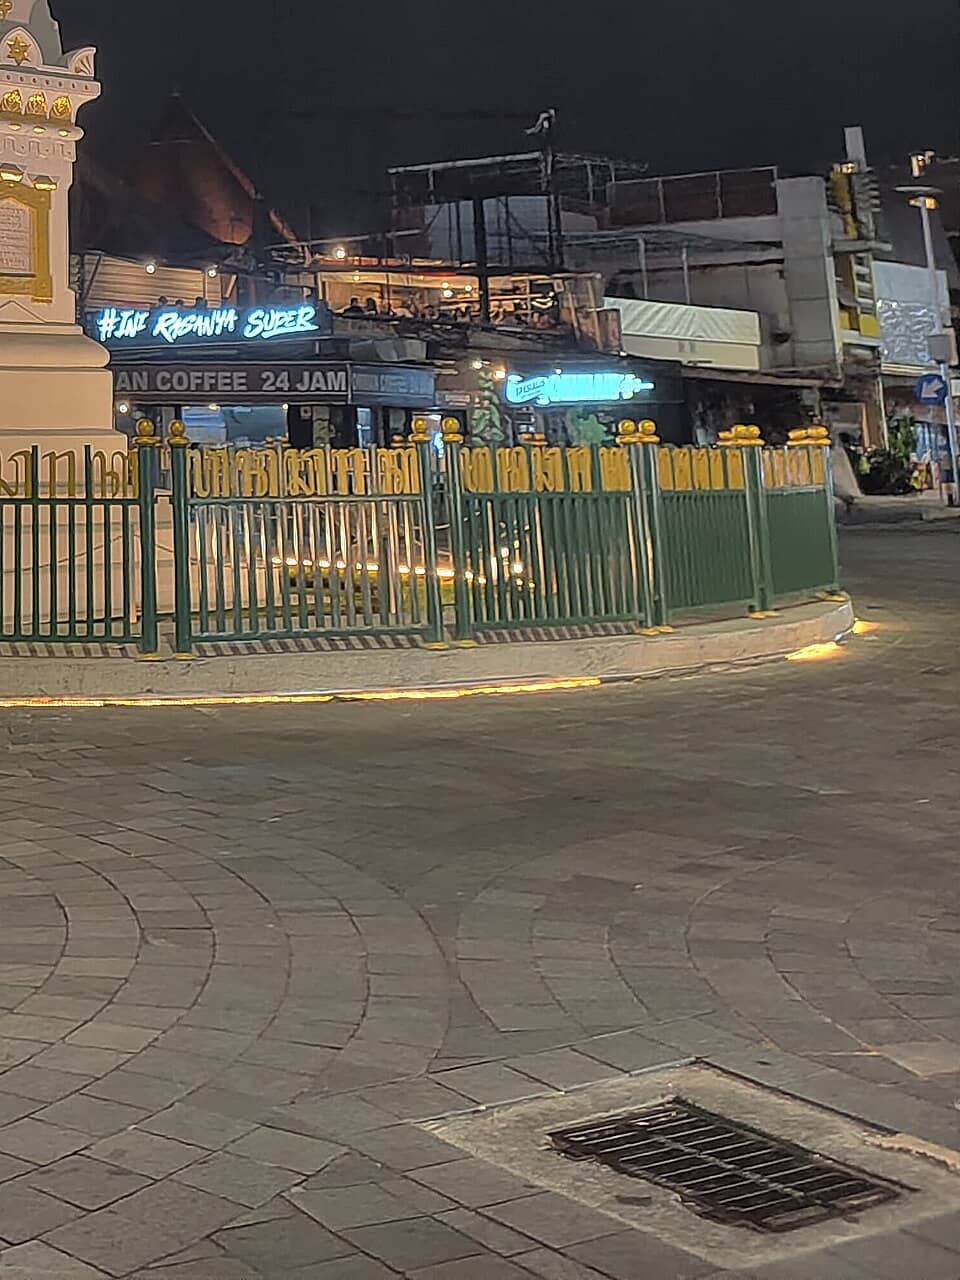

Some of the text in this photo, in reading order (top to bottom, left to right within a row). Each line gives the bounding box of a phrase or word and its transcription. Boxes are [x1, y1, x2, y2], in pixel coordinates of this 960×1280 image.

[155, 370, 248, 391] COFFEE
[260, 371, 290, 391] 24
[295, 370, 347, 391] JAM
